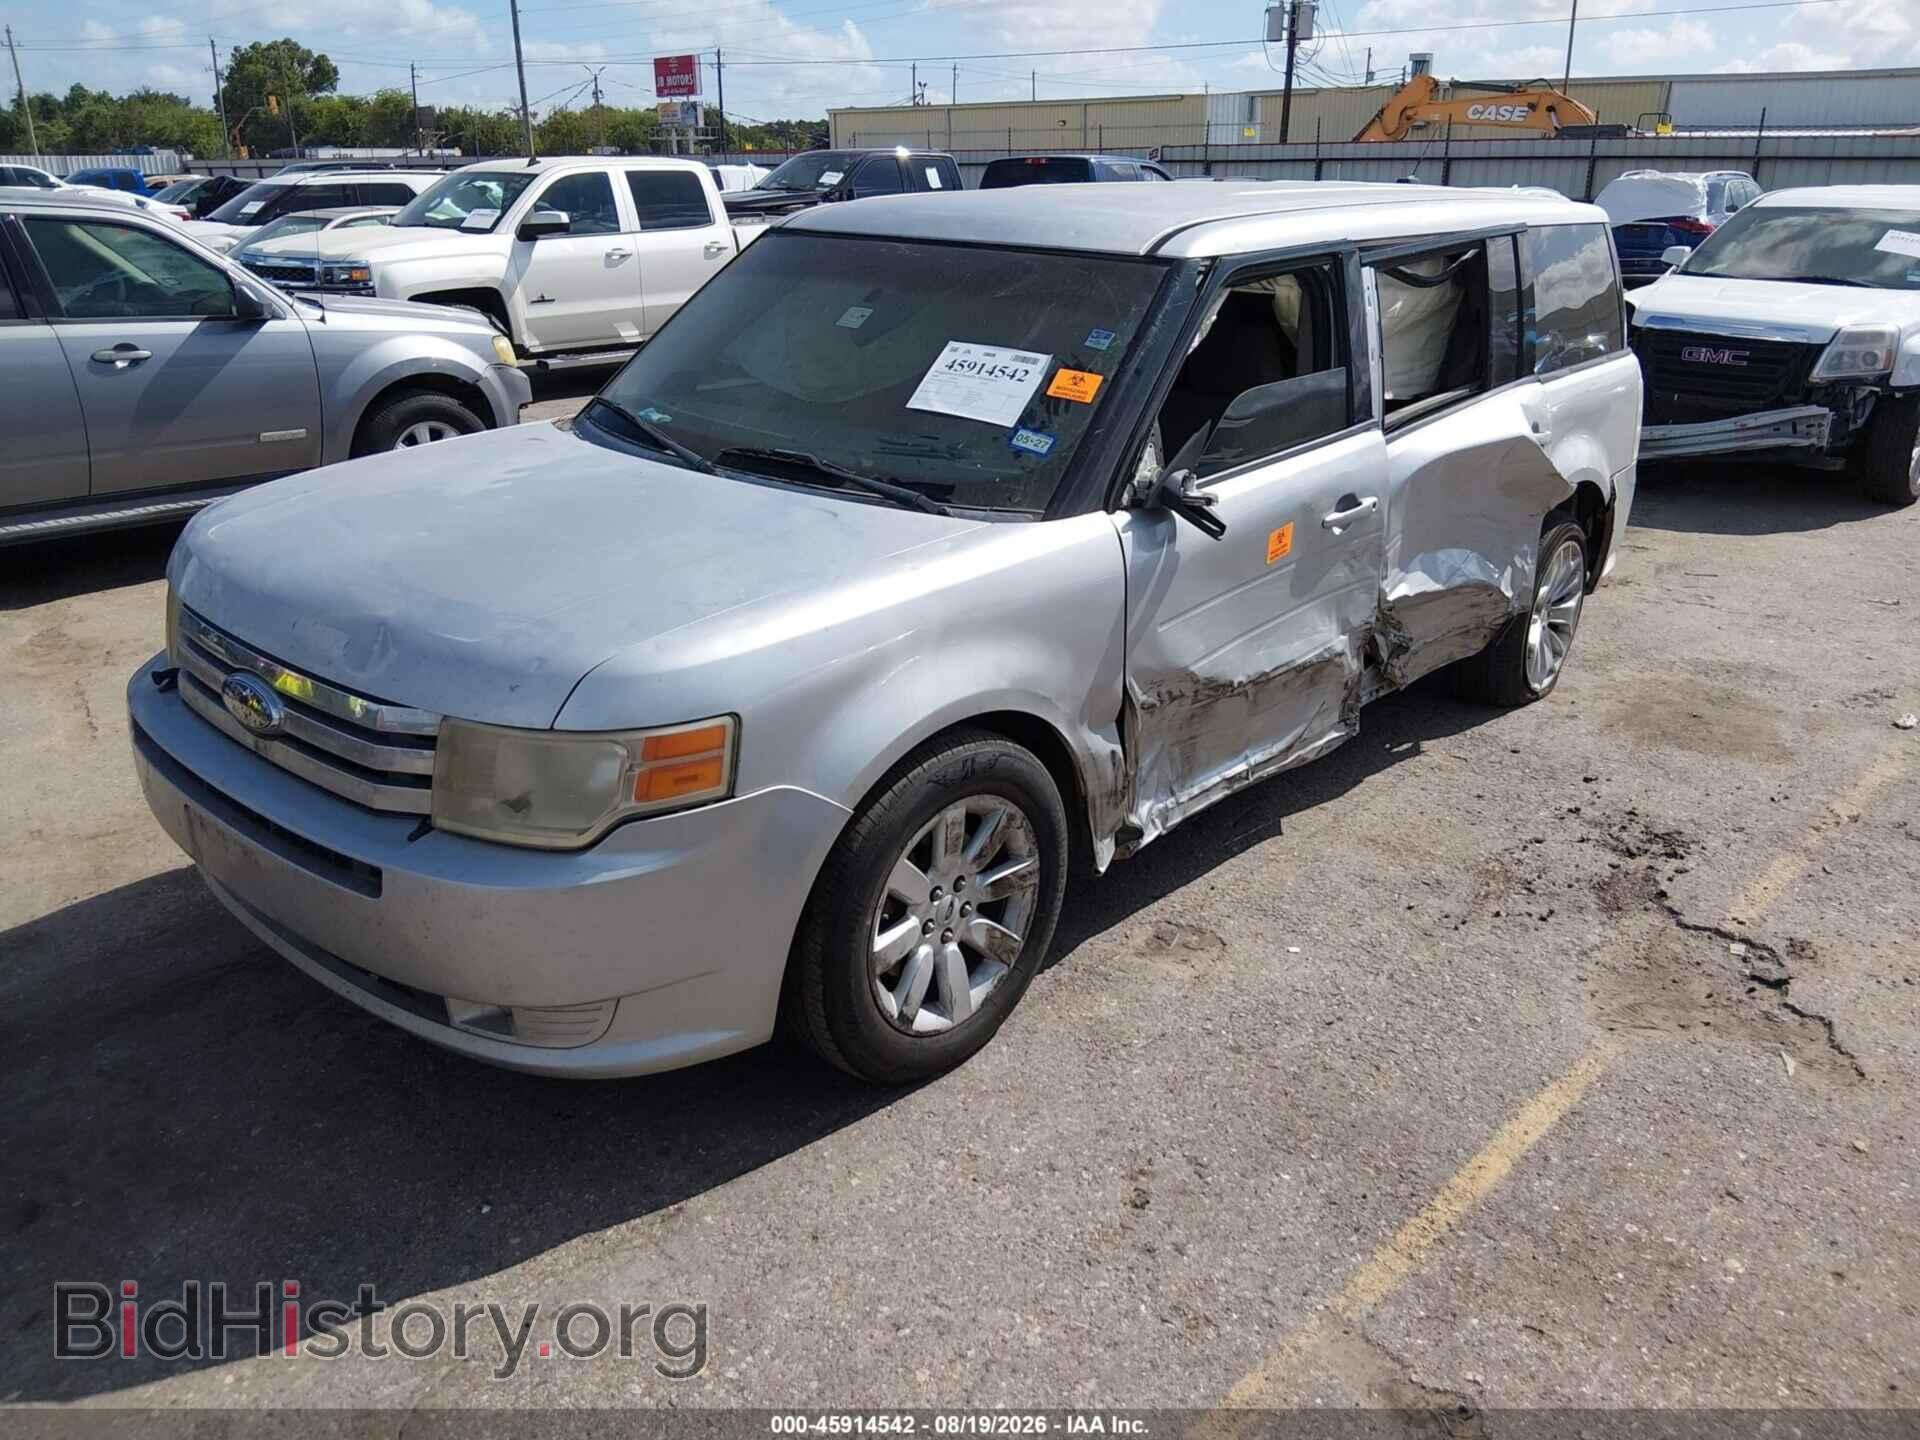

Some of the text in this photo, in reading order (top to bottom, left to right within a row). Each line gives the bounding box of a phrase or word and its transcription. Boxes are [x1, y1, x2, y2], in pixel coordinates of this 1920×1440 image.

[666, 73, 694, 87] MOTORS
[1465, 104, 1530, 122] CASE
[1681, 346, 1750, 366] GMC
[944, 358, 1030, 383] 45914542
